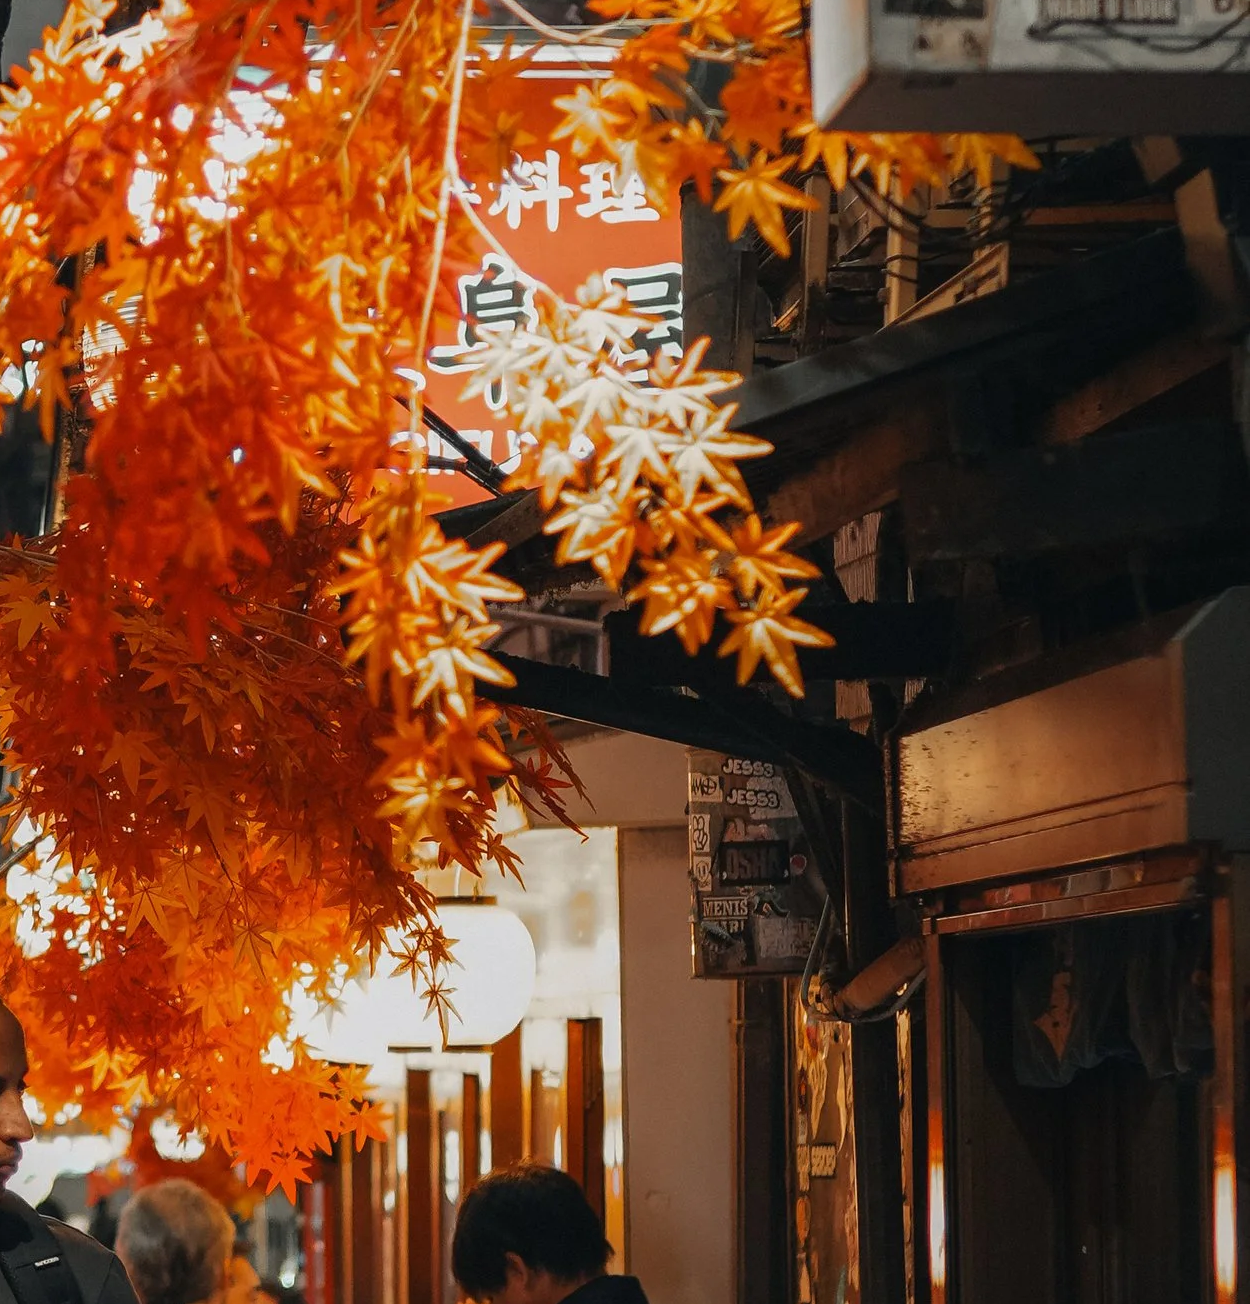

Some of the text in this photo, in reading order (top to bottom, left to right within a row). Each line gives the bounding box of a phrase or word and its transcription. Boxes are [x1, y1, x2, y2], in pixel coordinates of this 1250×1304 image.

[722, 758, 774, 777] JESS3
[727, 789, 779, 808] JESS3
[703, 900, 748, 917] MENIS
